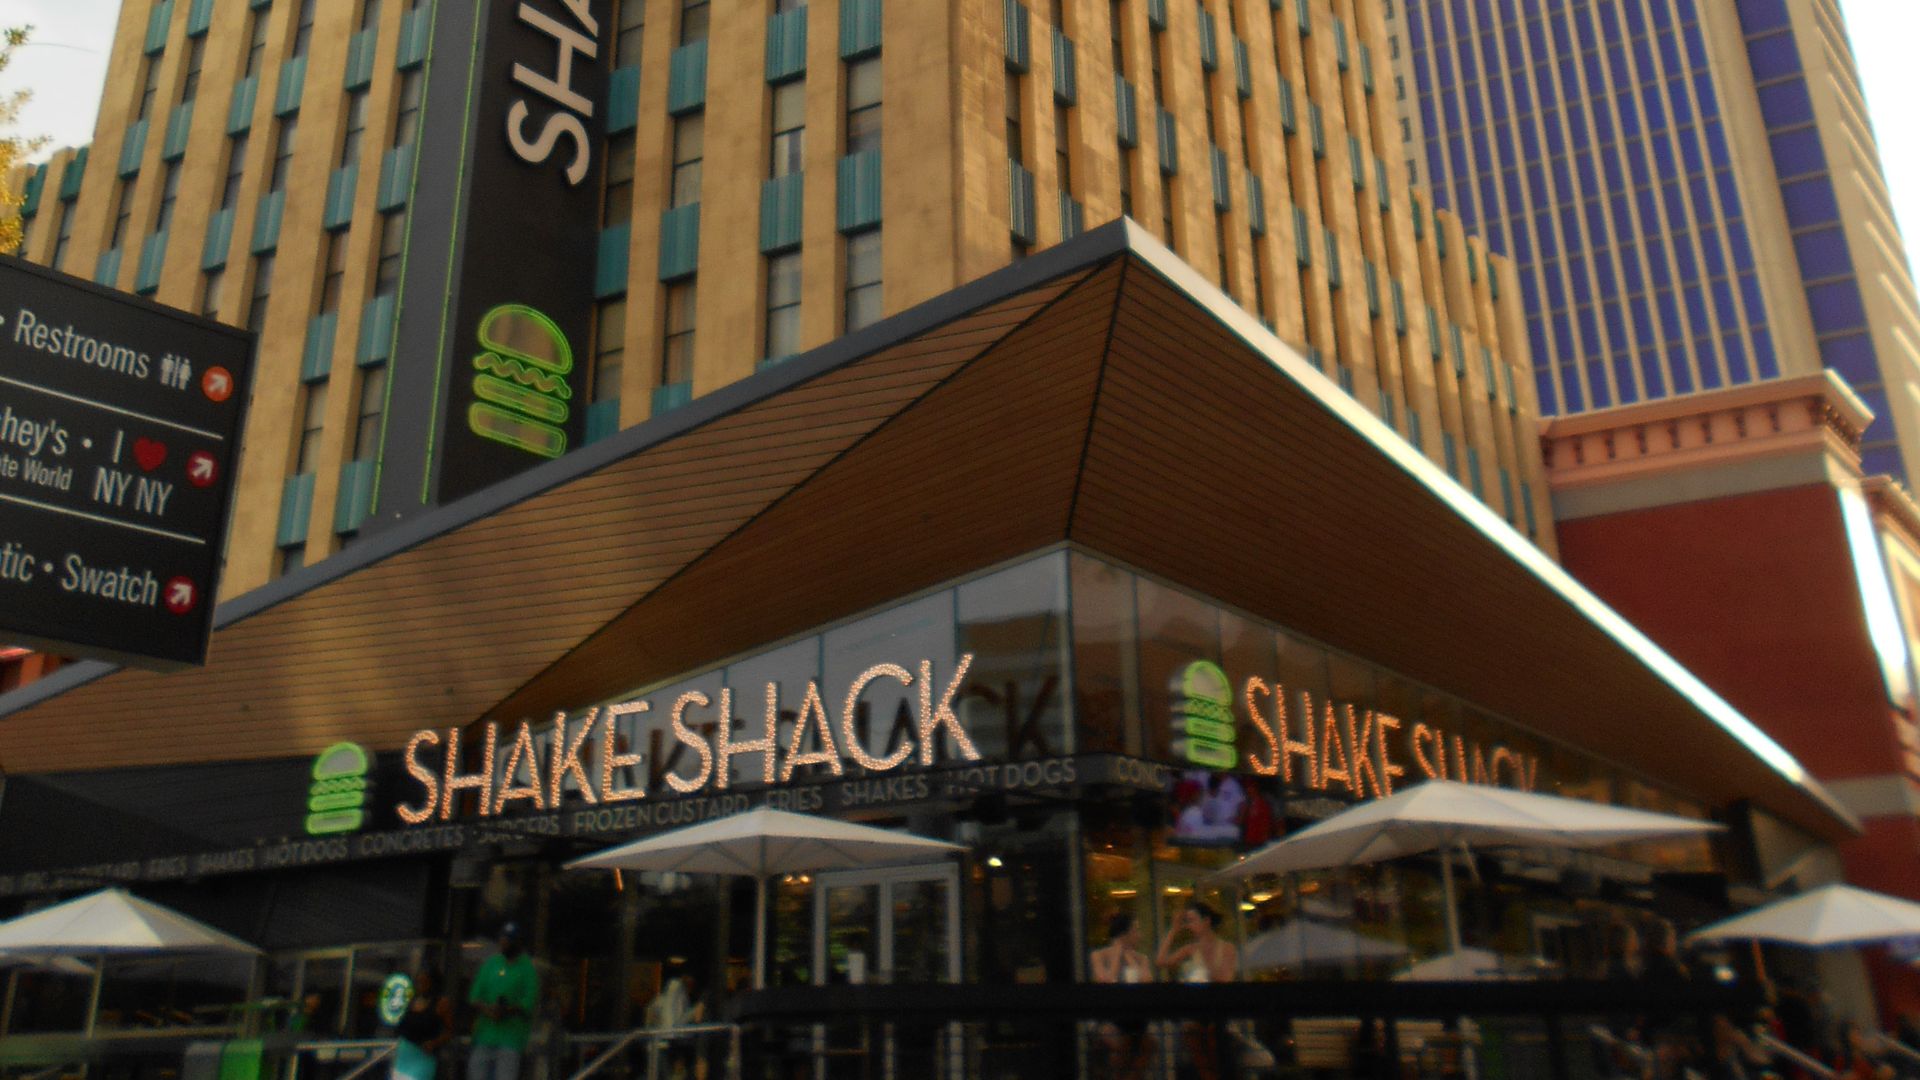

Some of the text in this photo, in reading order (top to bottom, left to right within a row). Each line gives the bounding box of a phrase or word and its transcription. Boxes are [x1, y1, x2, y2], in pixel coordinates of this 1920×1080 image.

[14, 308, 150, 379] Restrooms
[0, 406, 68, 456] hey's
[113, 430, 124, 464] I
[24, 458, 73, 490] World
[93, 467, 173, 516] NY NY
[0, 542, 158, 606] tic Swatch
[395, 653, 982, 824] SHAKE SHACK
[1247, 675, 1404, 799] SHAKE
[360, 826, 465, 855] CONCRETES
[574, 804, 651, 833] FROZEN
[655, 793, 750, 825] CUSTARD
[766, 785, 823, 811] FRIES
[841, 773, 929, 806] SHAKES
[1005, 758, 1077, 789] DOGS
